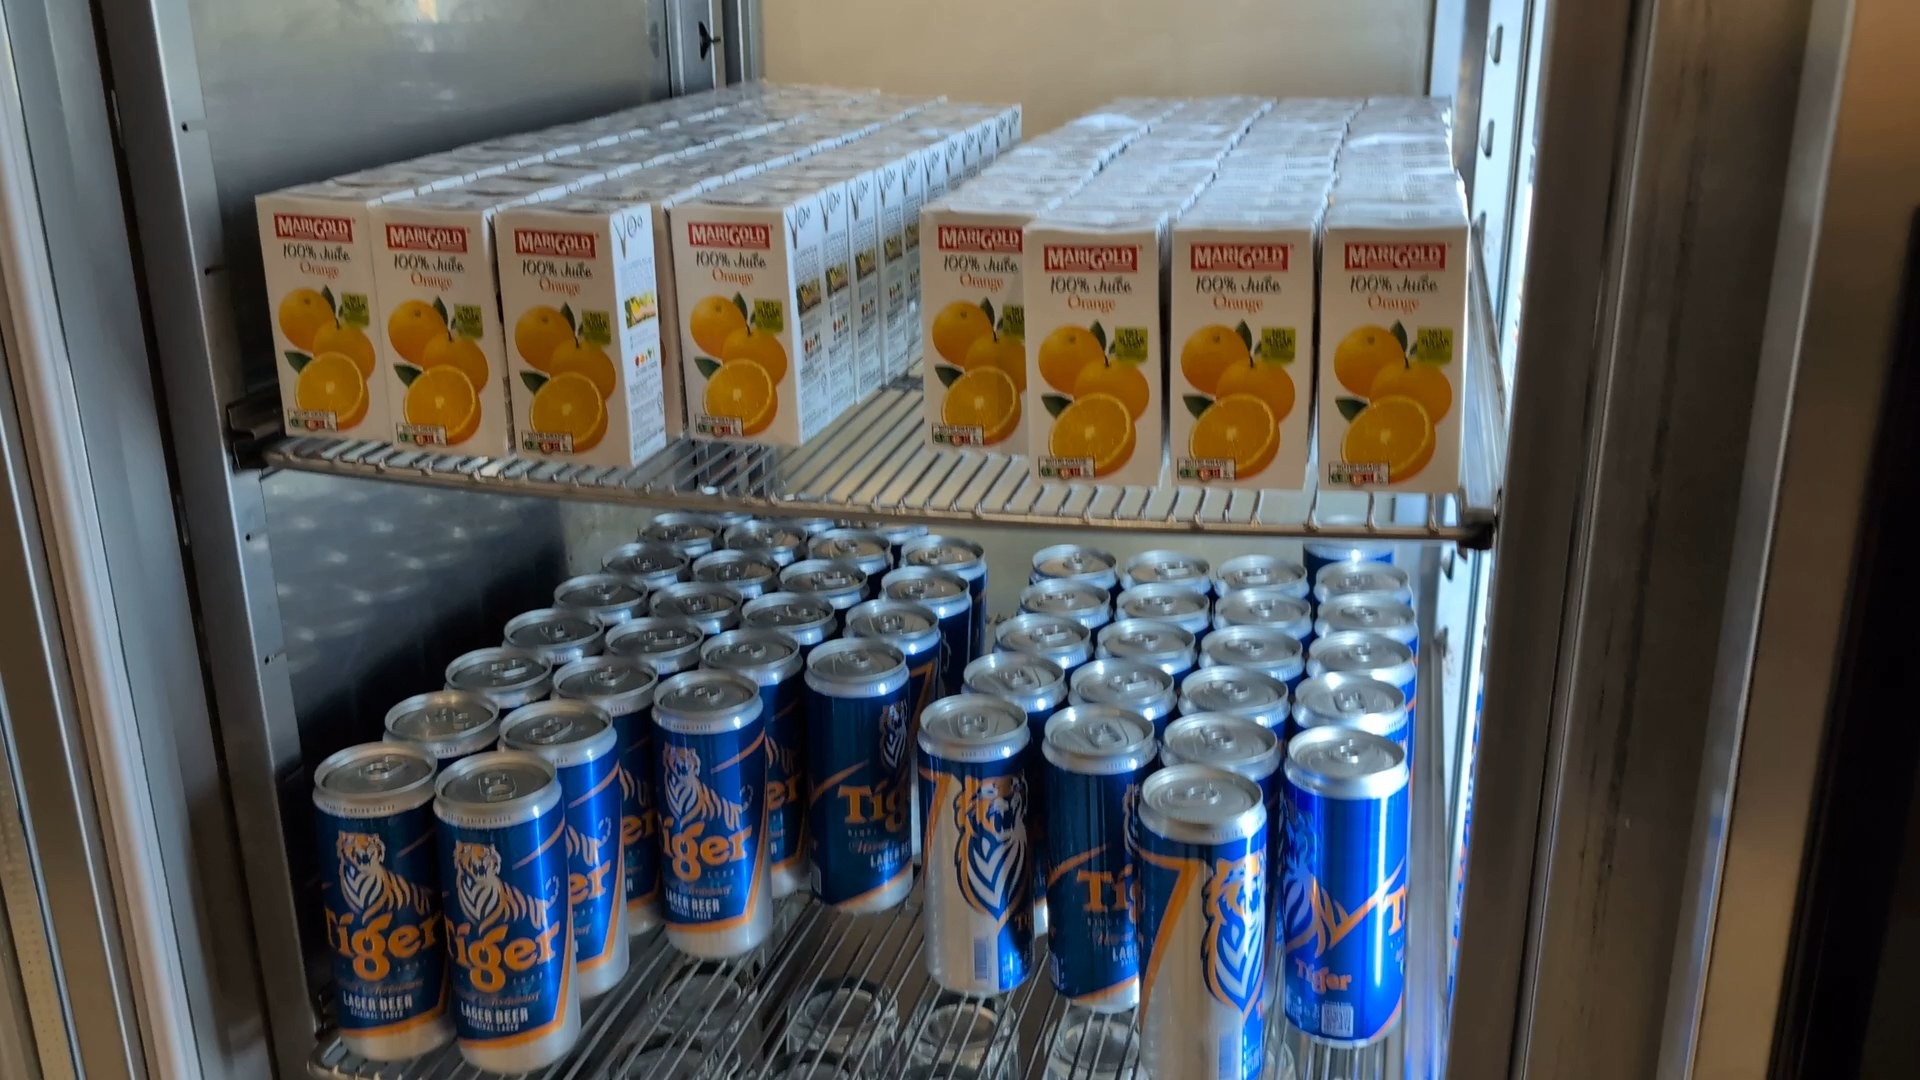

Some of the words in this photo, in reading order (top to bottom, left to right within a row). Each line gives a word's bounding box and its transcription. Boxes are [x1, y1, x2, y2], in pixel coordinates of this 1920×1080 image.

[278, 217, 348, 239] MARIGOLD
[692, 225, 766, 245] MARIGOLD
[390, 227, 462, 249] MARIGOLD
[519, 232, 590, 255] MARIGOLD
[942, 228, 1019, 249] MARIGOLD
[283, 243, 316, 261] 100%
[319, 246, 350, 262] Juice
[696, 251, 731, 268] 100%
[734, 252, 766, 269] Juice
[1048, 247, 1133, 269] MARIGOLD
[1194, 246, 1283, 268] MARIGOLD
[1349, 246, 1440, 268] MARIGOLD
[300, 262, 339, 279] Orange
[393, 253, 430, 271] 100%
[432, 255, 464, 273] Juice
[522, 259, 558, 276] 100%
[561, 261, 593, 279] Juice
[944, 255, 980, 272] 100%
[984, 256, 1018, 273] Juice
[411, 273, 453, 291] Orange
[539, 277, 581, 296] Orange
[712, 268, 754, 286] Orange
[960, 273, 1003, 291] Orange
[1050, 277, 1090, 294] 100%
[1094, 278, 1132, 294] Juice
[1196, 275, 1237, 293] 100%
[1241, 276, 1282, 295] Juice
[1350, 274, 1392, 293] 100%
[1397, 275, 1438, 293] Juice
[1068, 294, 1115, 312] Orange
[1213, 294, 1263, 313] Orange
[1368, 294, 1419, 313] Orange
[660, 815, 752, 882] iger
[496, 1008, 528, 1024] BEER
